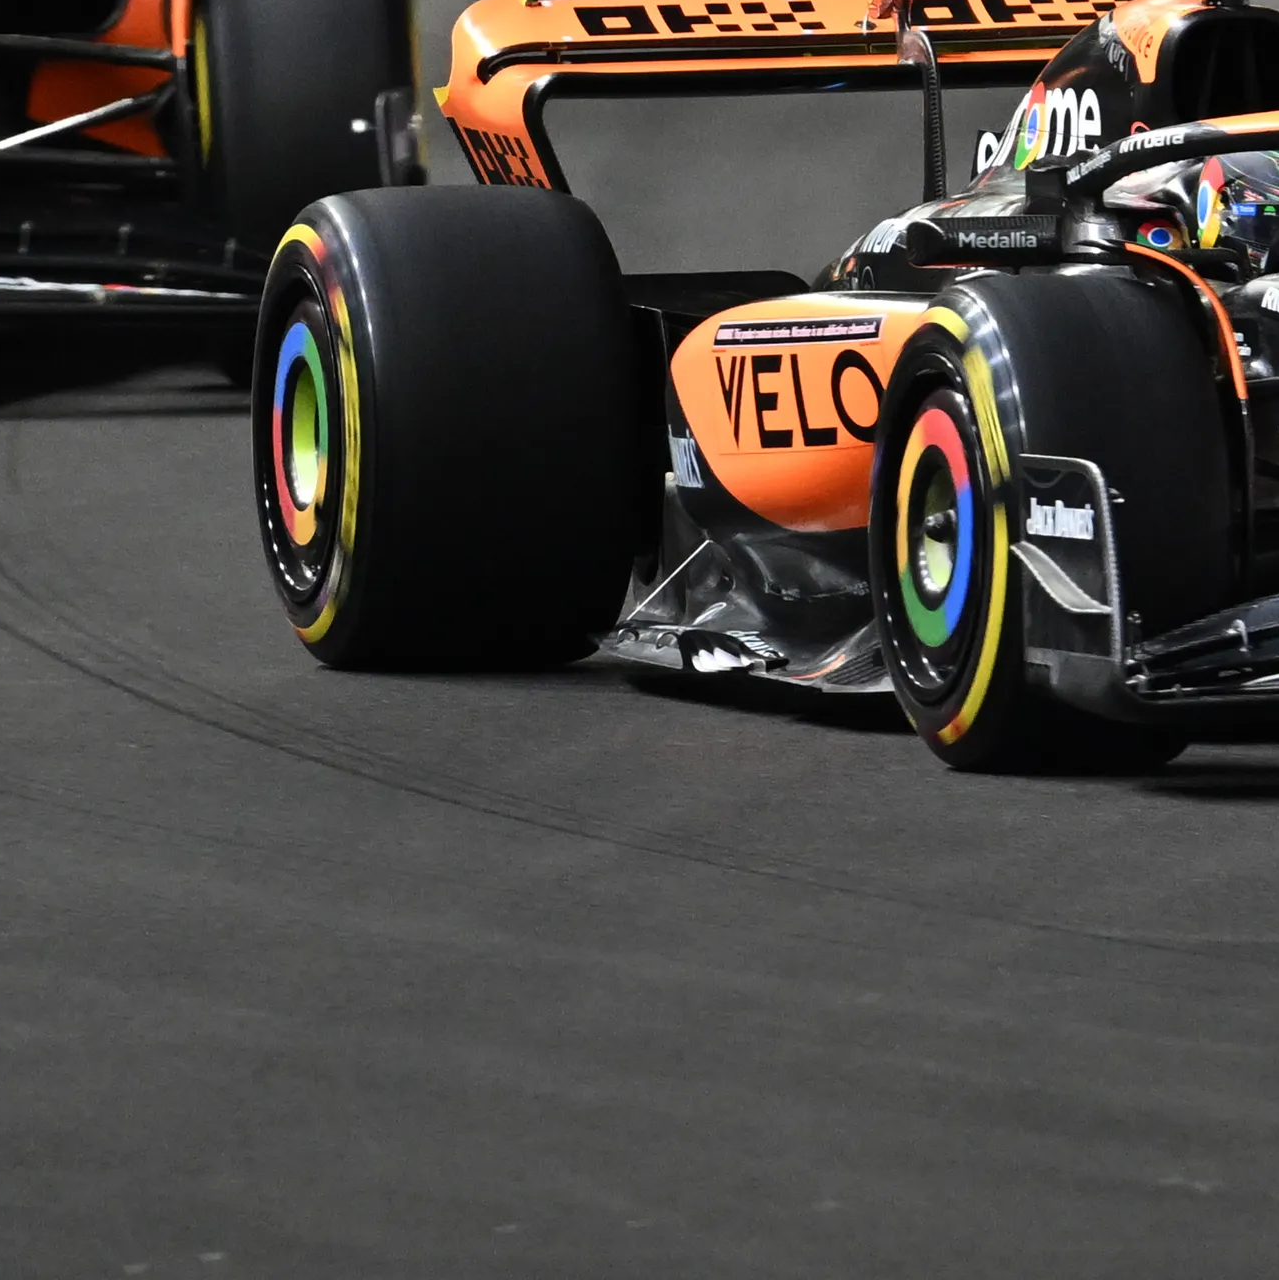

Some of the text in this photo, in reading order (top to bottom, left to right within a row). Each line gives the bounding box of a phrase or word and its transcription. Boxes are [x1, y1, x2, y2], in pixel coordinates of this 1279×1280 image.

[574, 0, 826, 37] OKX
[958, 231, 1038, 248] Medallia
[715, 349, 885, 451] VELO
